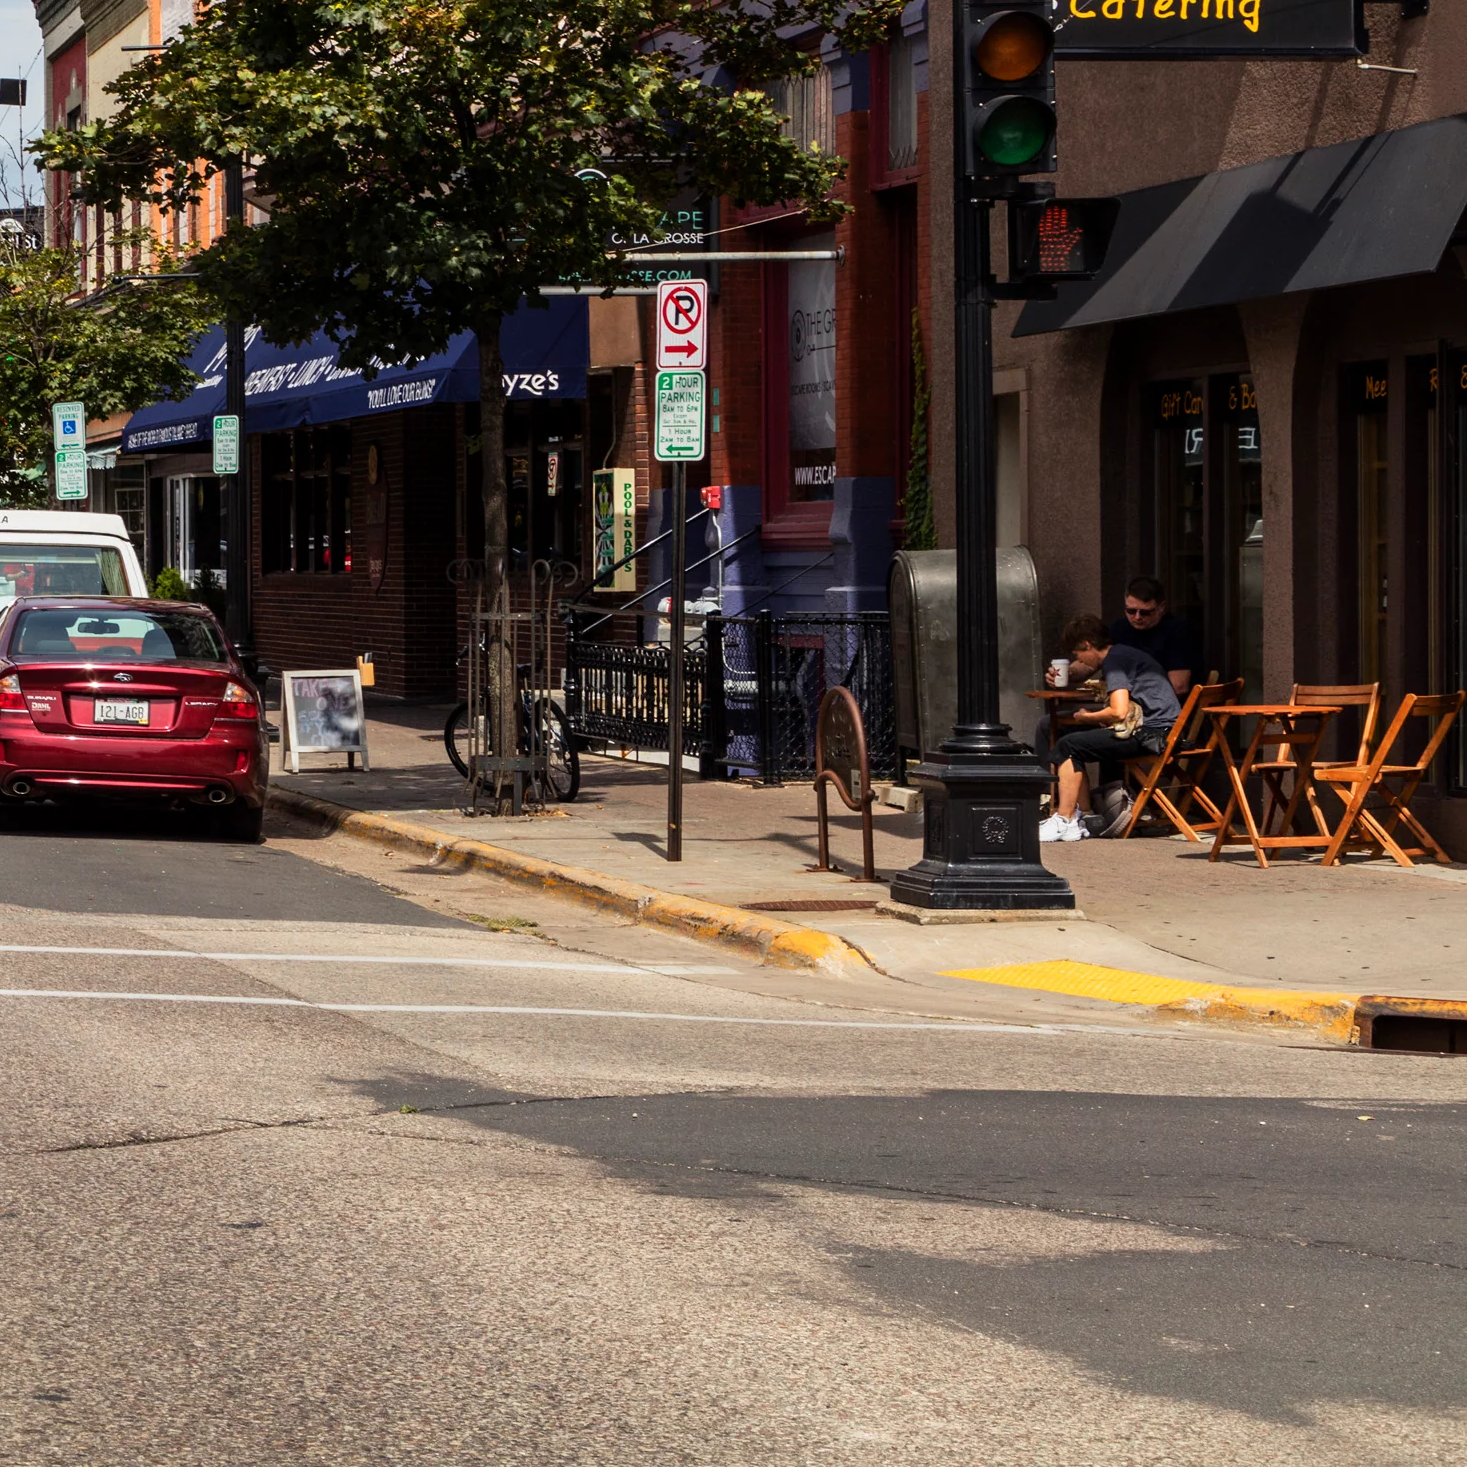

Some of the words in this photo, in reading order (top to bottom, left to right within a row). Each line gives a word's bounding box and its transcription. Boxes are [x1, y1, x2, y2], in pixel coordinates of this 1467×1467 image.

[24, 234, 38, 250] St
[633, 233, 650, 244] LA
[286, 355, 335, 389] LUNCH
[662, 377, 670, 388] 2
[675, 377, 699, 388] HOUR
[661, 391, 700, 403] PARKING
[1161, 393, 1181, 419] Gift
[222, 420, 236, 428] HOUR
[623, 483, 632, 517] POOL
[623, 519, 632, 528] &
[623, 530, 632, 573] DARS
[99, 705, 145, 719] 121-AGB
